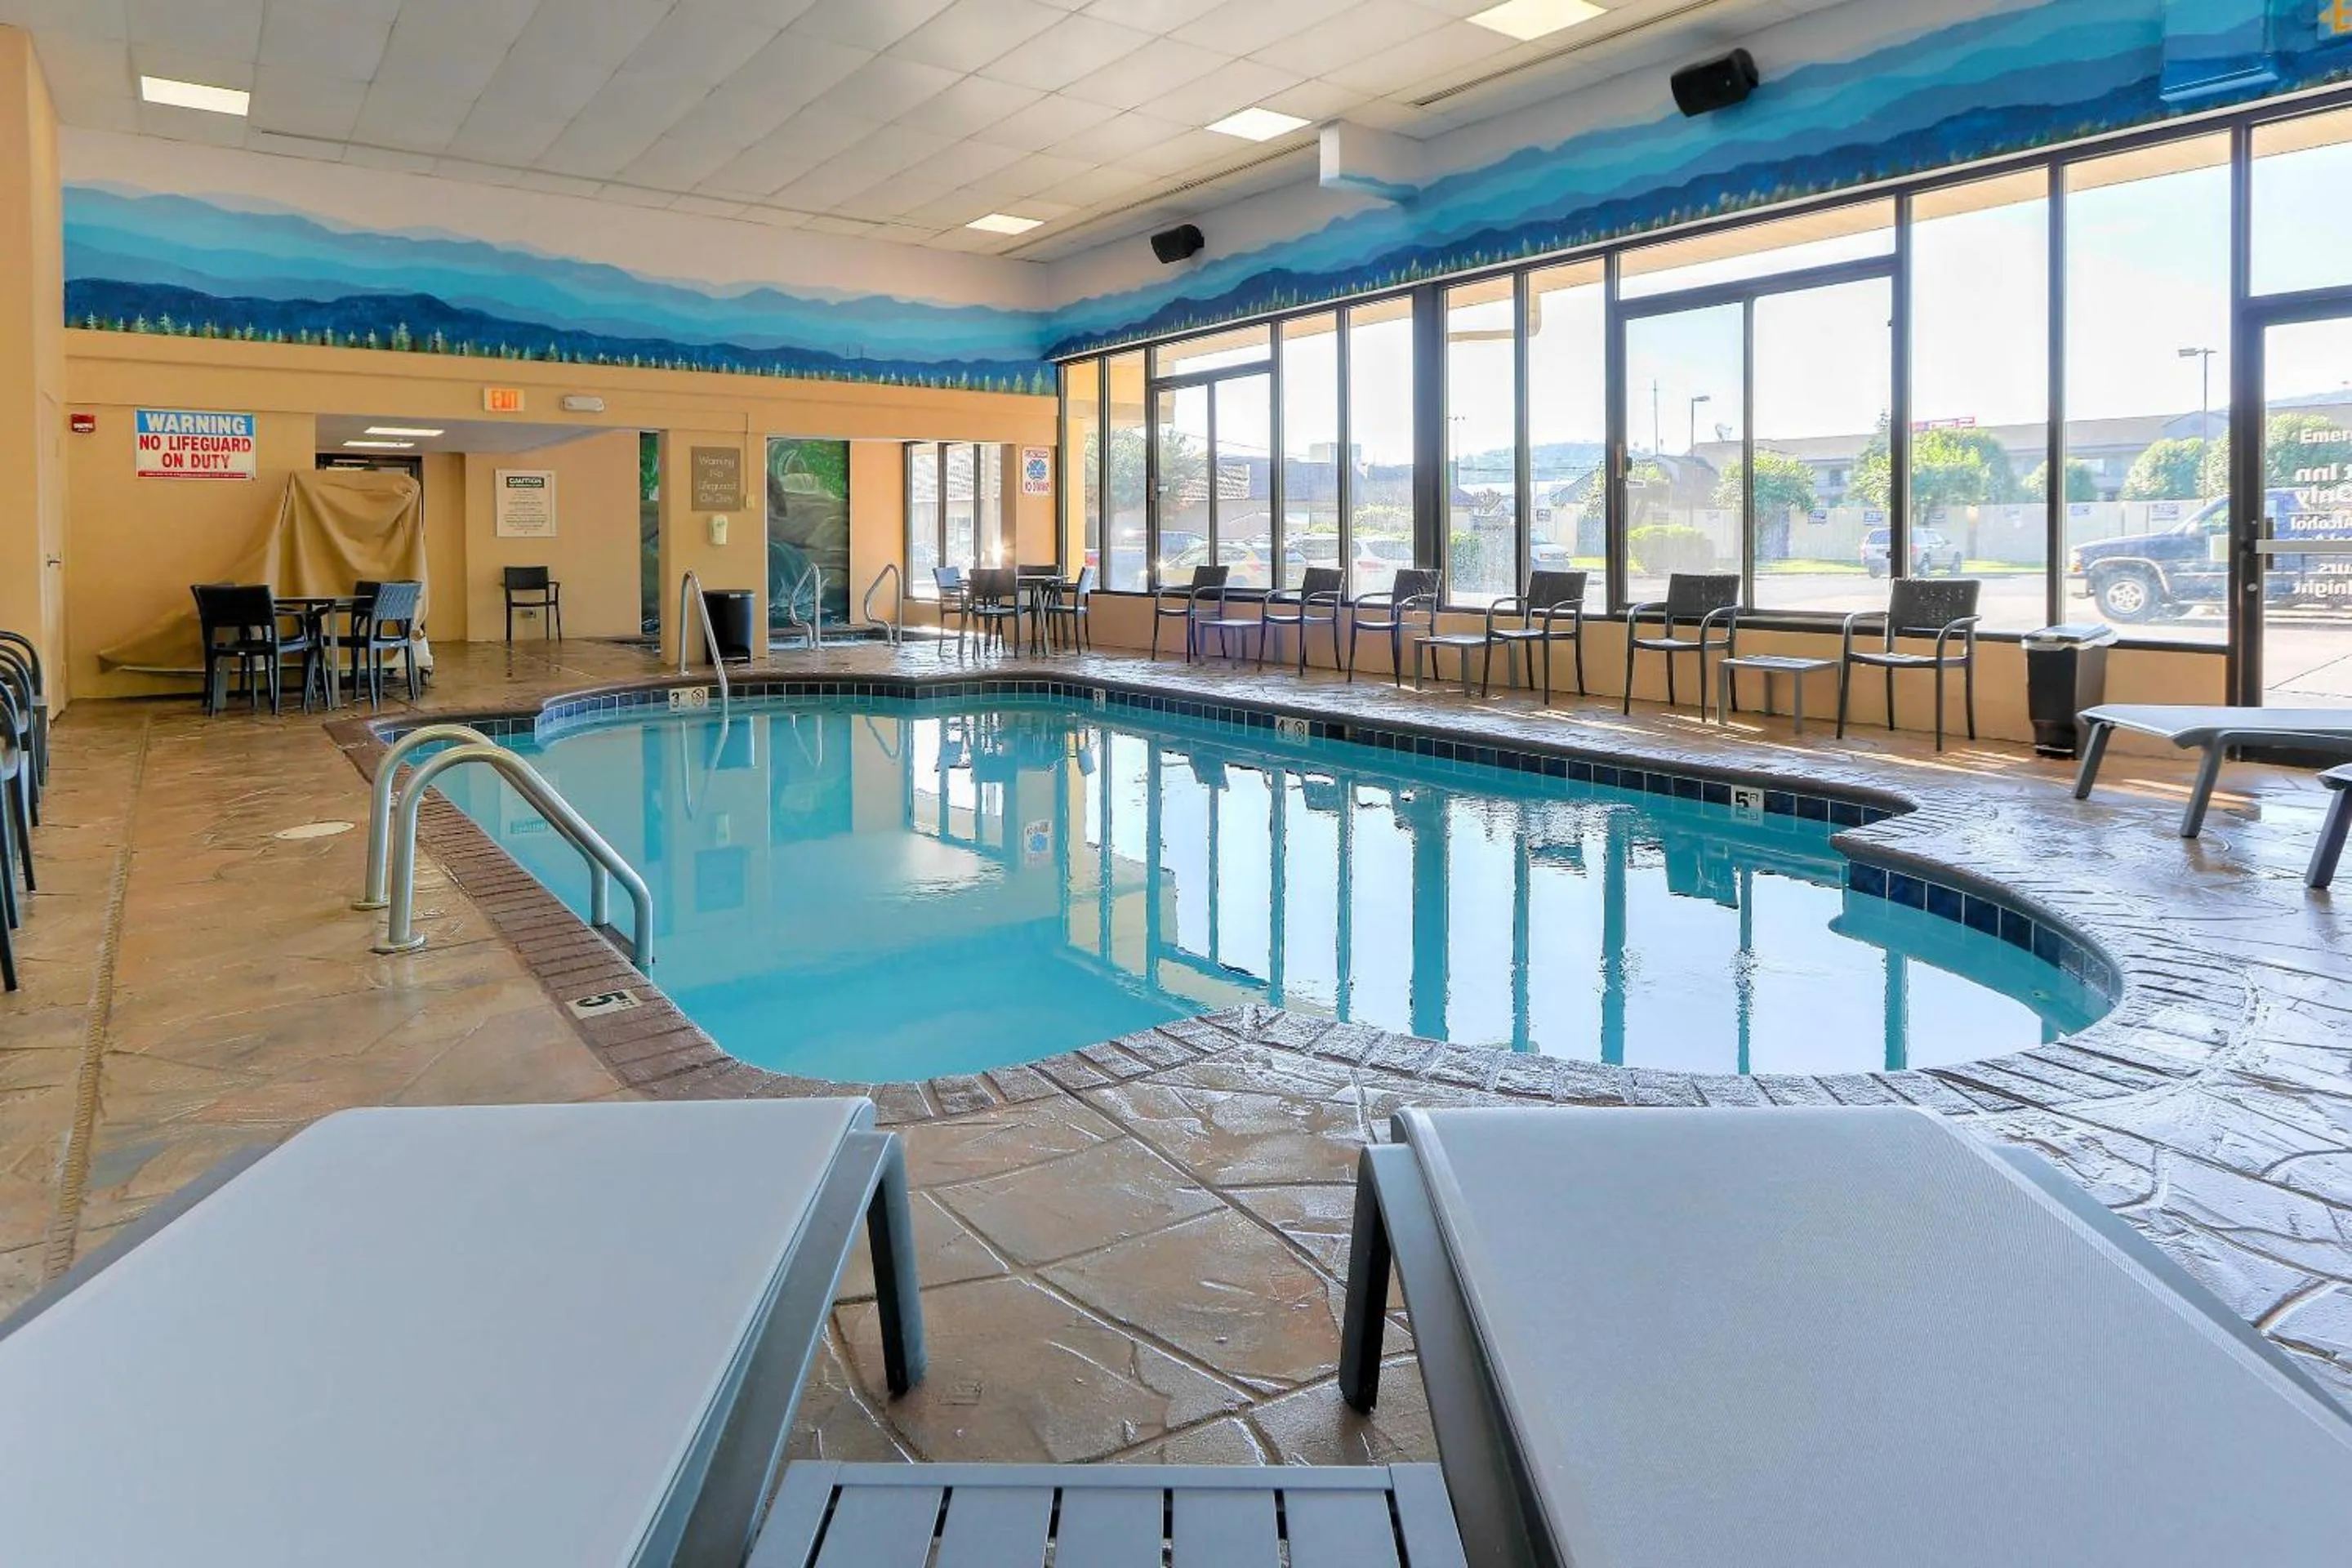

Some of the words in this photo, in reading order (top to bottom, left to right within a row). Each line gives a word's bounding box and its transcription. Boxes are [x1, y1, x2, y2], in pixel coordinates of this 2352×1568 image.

[145, 412, 247, 434] WARNING
[139, 435, 161, 450] NO
[169, 436, 252, 452] LIFEGUARD
[2300, 429, 2352, 443] Emer
[162, 452, 184, 468] ON
[191, 453, 229, 469] DUTY
